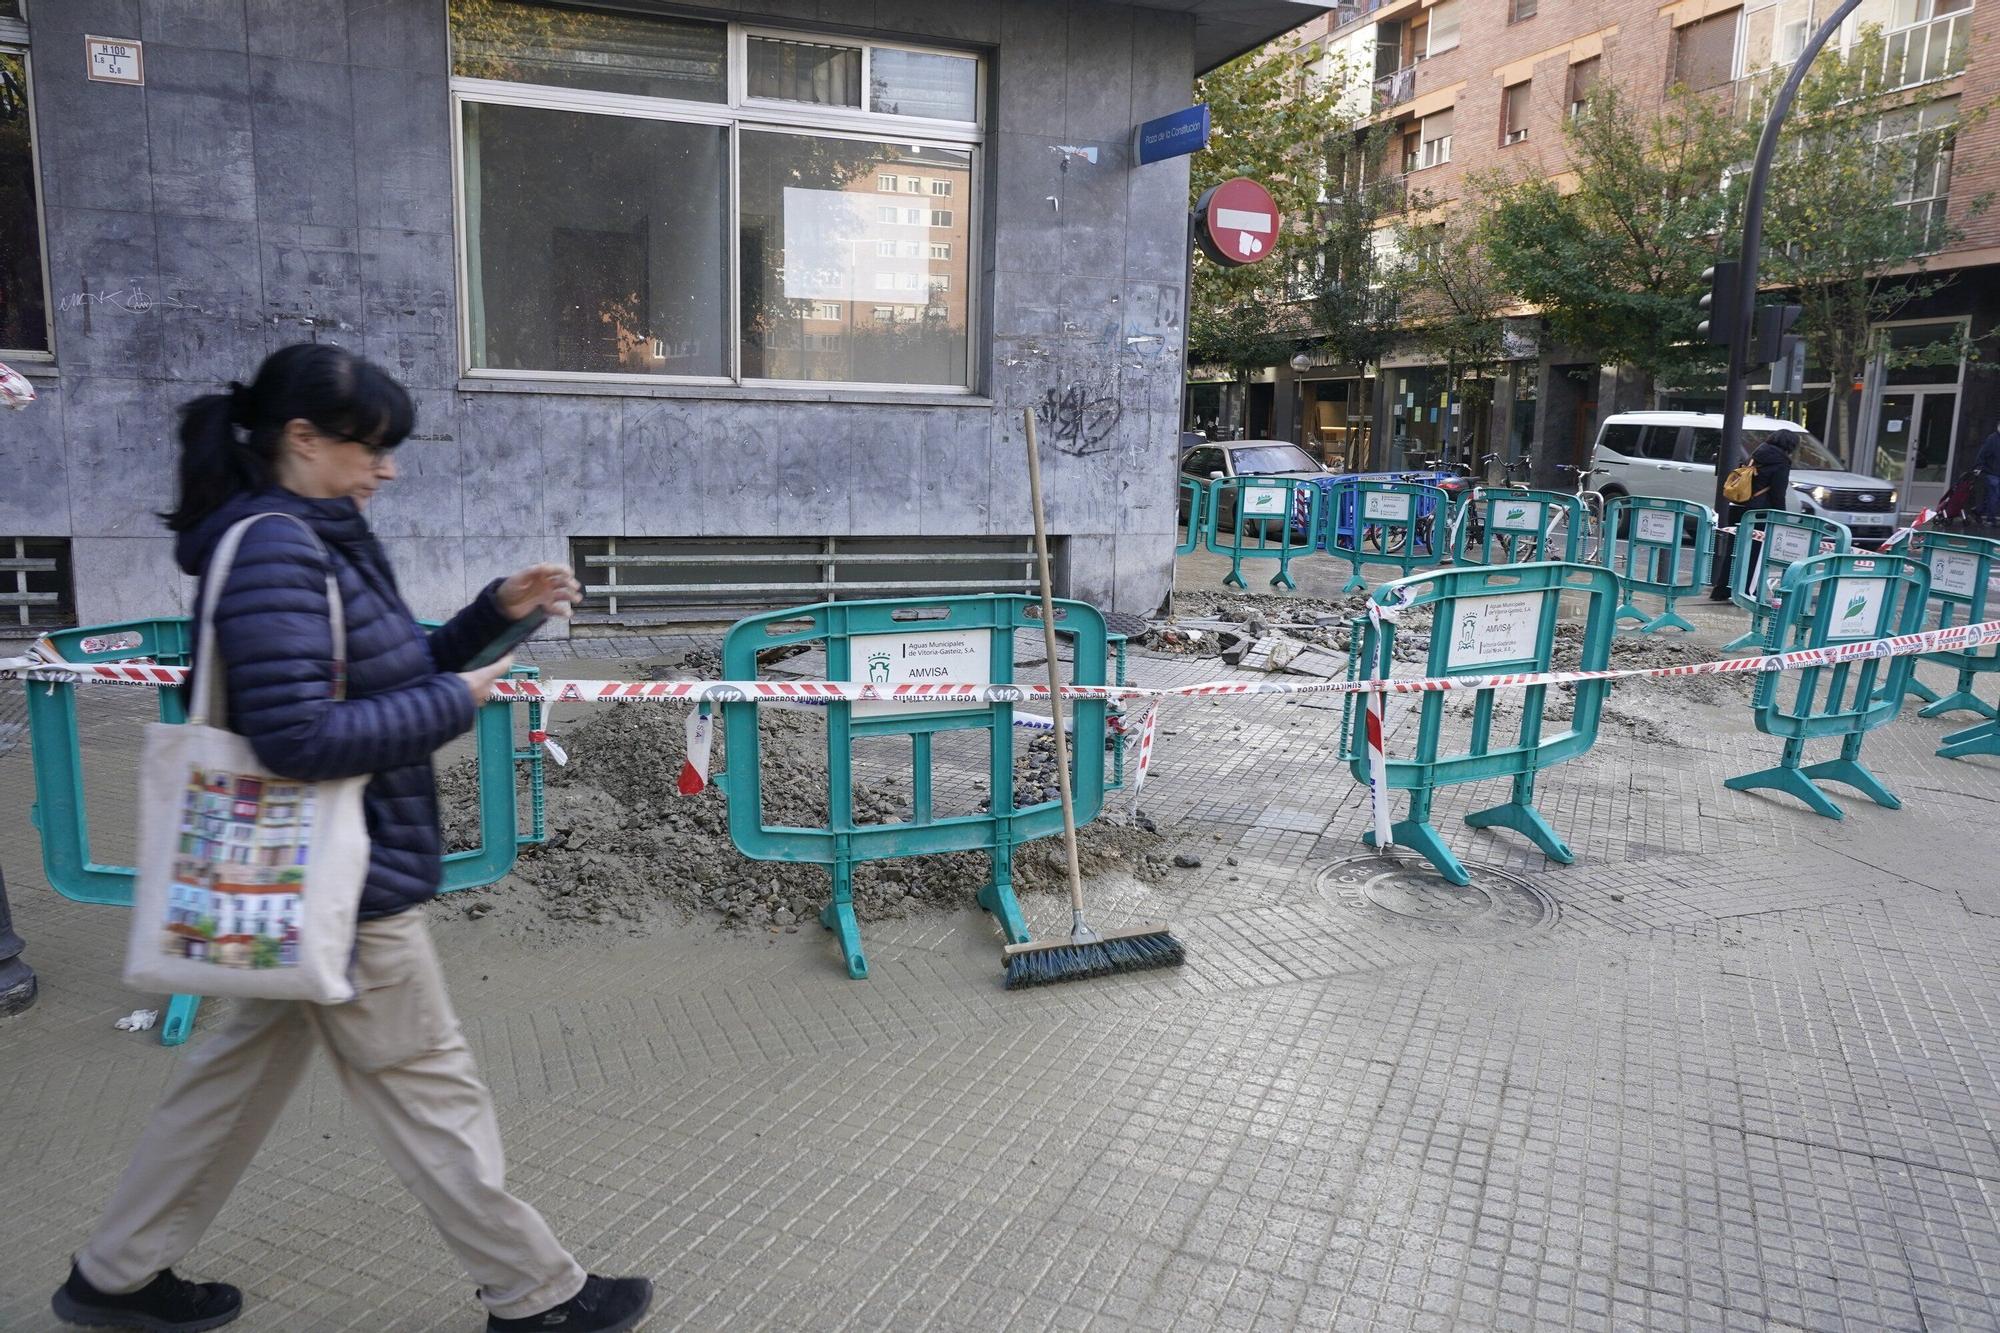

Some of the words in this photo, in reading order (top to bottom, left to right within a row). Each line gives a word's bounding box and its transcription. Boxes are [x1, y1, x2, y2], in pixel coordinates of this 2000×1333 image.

[102, 45, 108, 54] H
[110, 46, 126, 55] 100
[1158, 133, 1165, 141] de
[1486, 624, 1511, 632] AMVISA
[929, 640, 965, 648] Municipales
[909, 667, 949, 678] AMVISA
[996, 689, 1020, 701] 112
